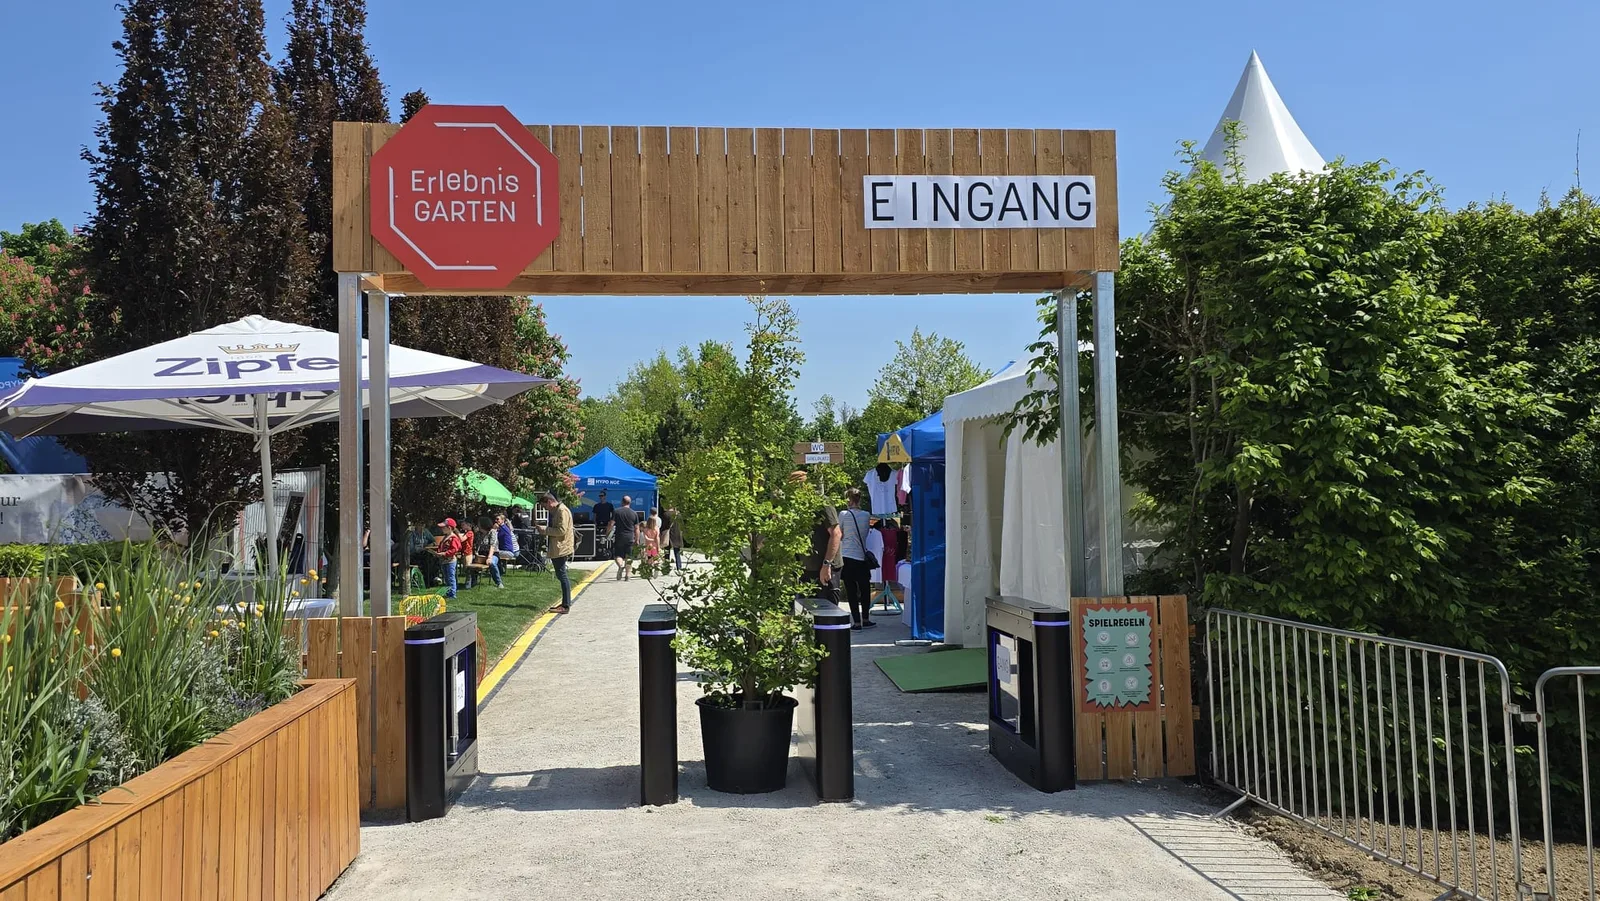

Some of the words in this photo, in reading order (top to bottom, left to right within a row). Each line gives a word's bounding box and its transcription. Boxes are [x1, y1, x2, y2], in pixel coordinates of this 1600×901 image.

[411, 167, 519, 194] Erlebnis
[414, 200, 516, 222] GARTEN
[871, 181, 1092, 222] EINGANG
[153, 353, 367, 380] Zipfe
[811, 443, 824, 451] WC
[1088, 617, 1145, 628] SPIELREGELN
